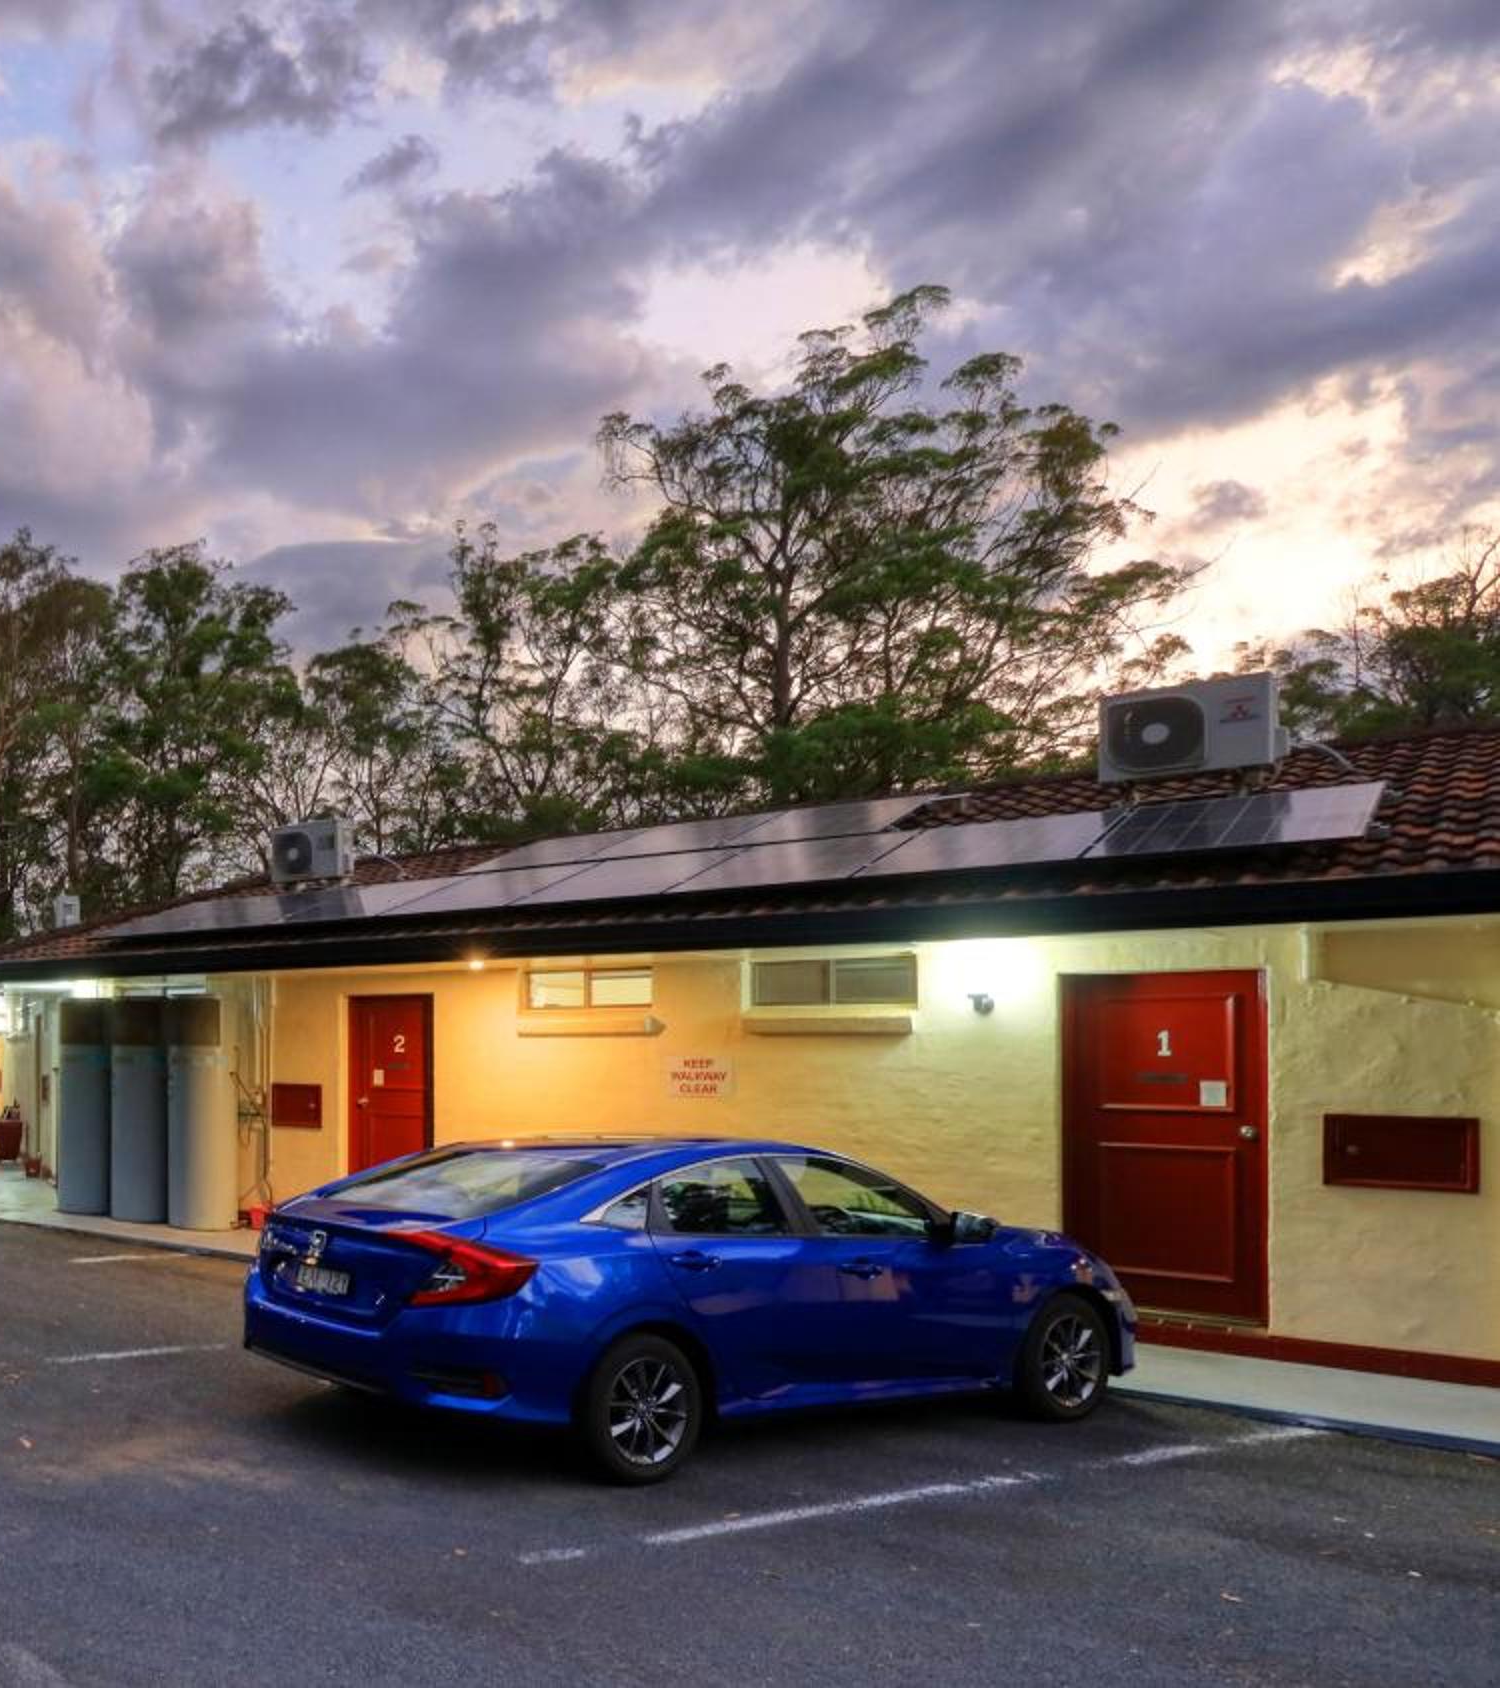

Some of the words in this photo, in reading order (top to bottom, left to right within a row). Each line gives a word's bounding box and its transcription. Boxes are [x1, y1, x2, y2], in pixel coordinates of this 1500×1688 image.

[393, 1034, 405, 1053] 2
[1157, 1029, 1172, 1056] 1
[683, 1059, 713, 1069] KEEP
[671, 1071, 727, 1081] WALKWAY
[679, 1083, 717, 1094] CLEAR
